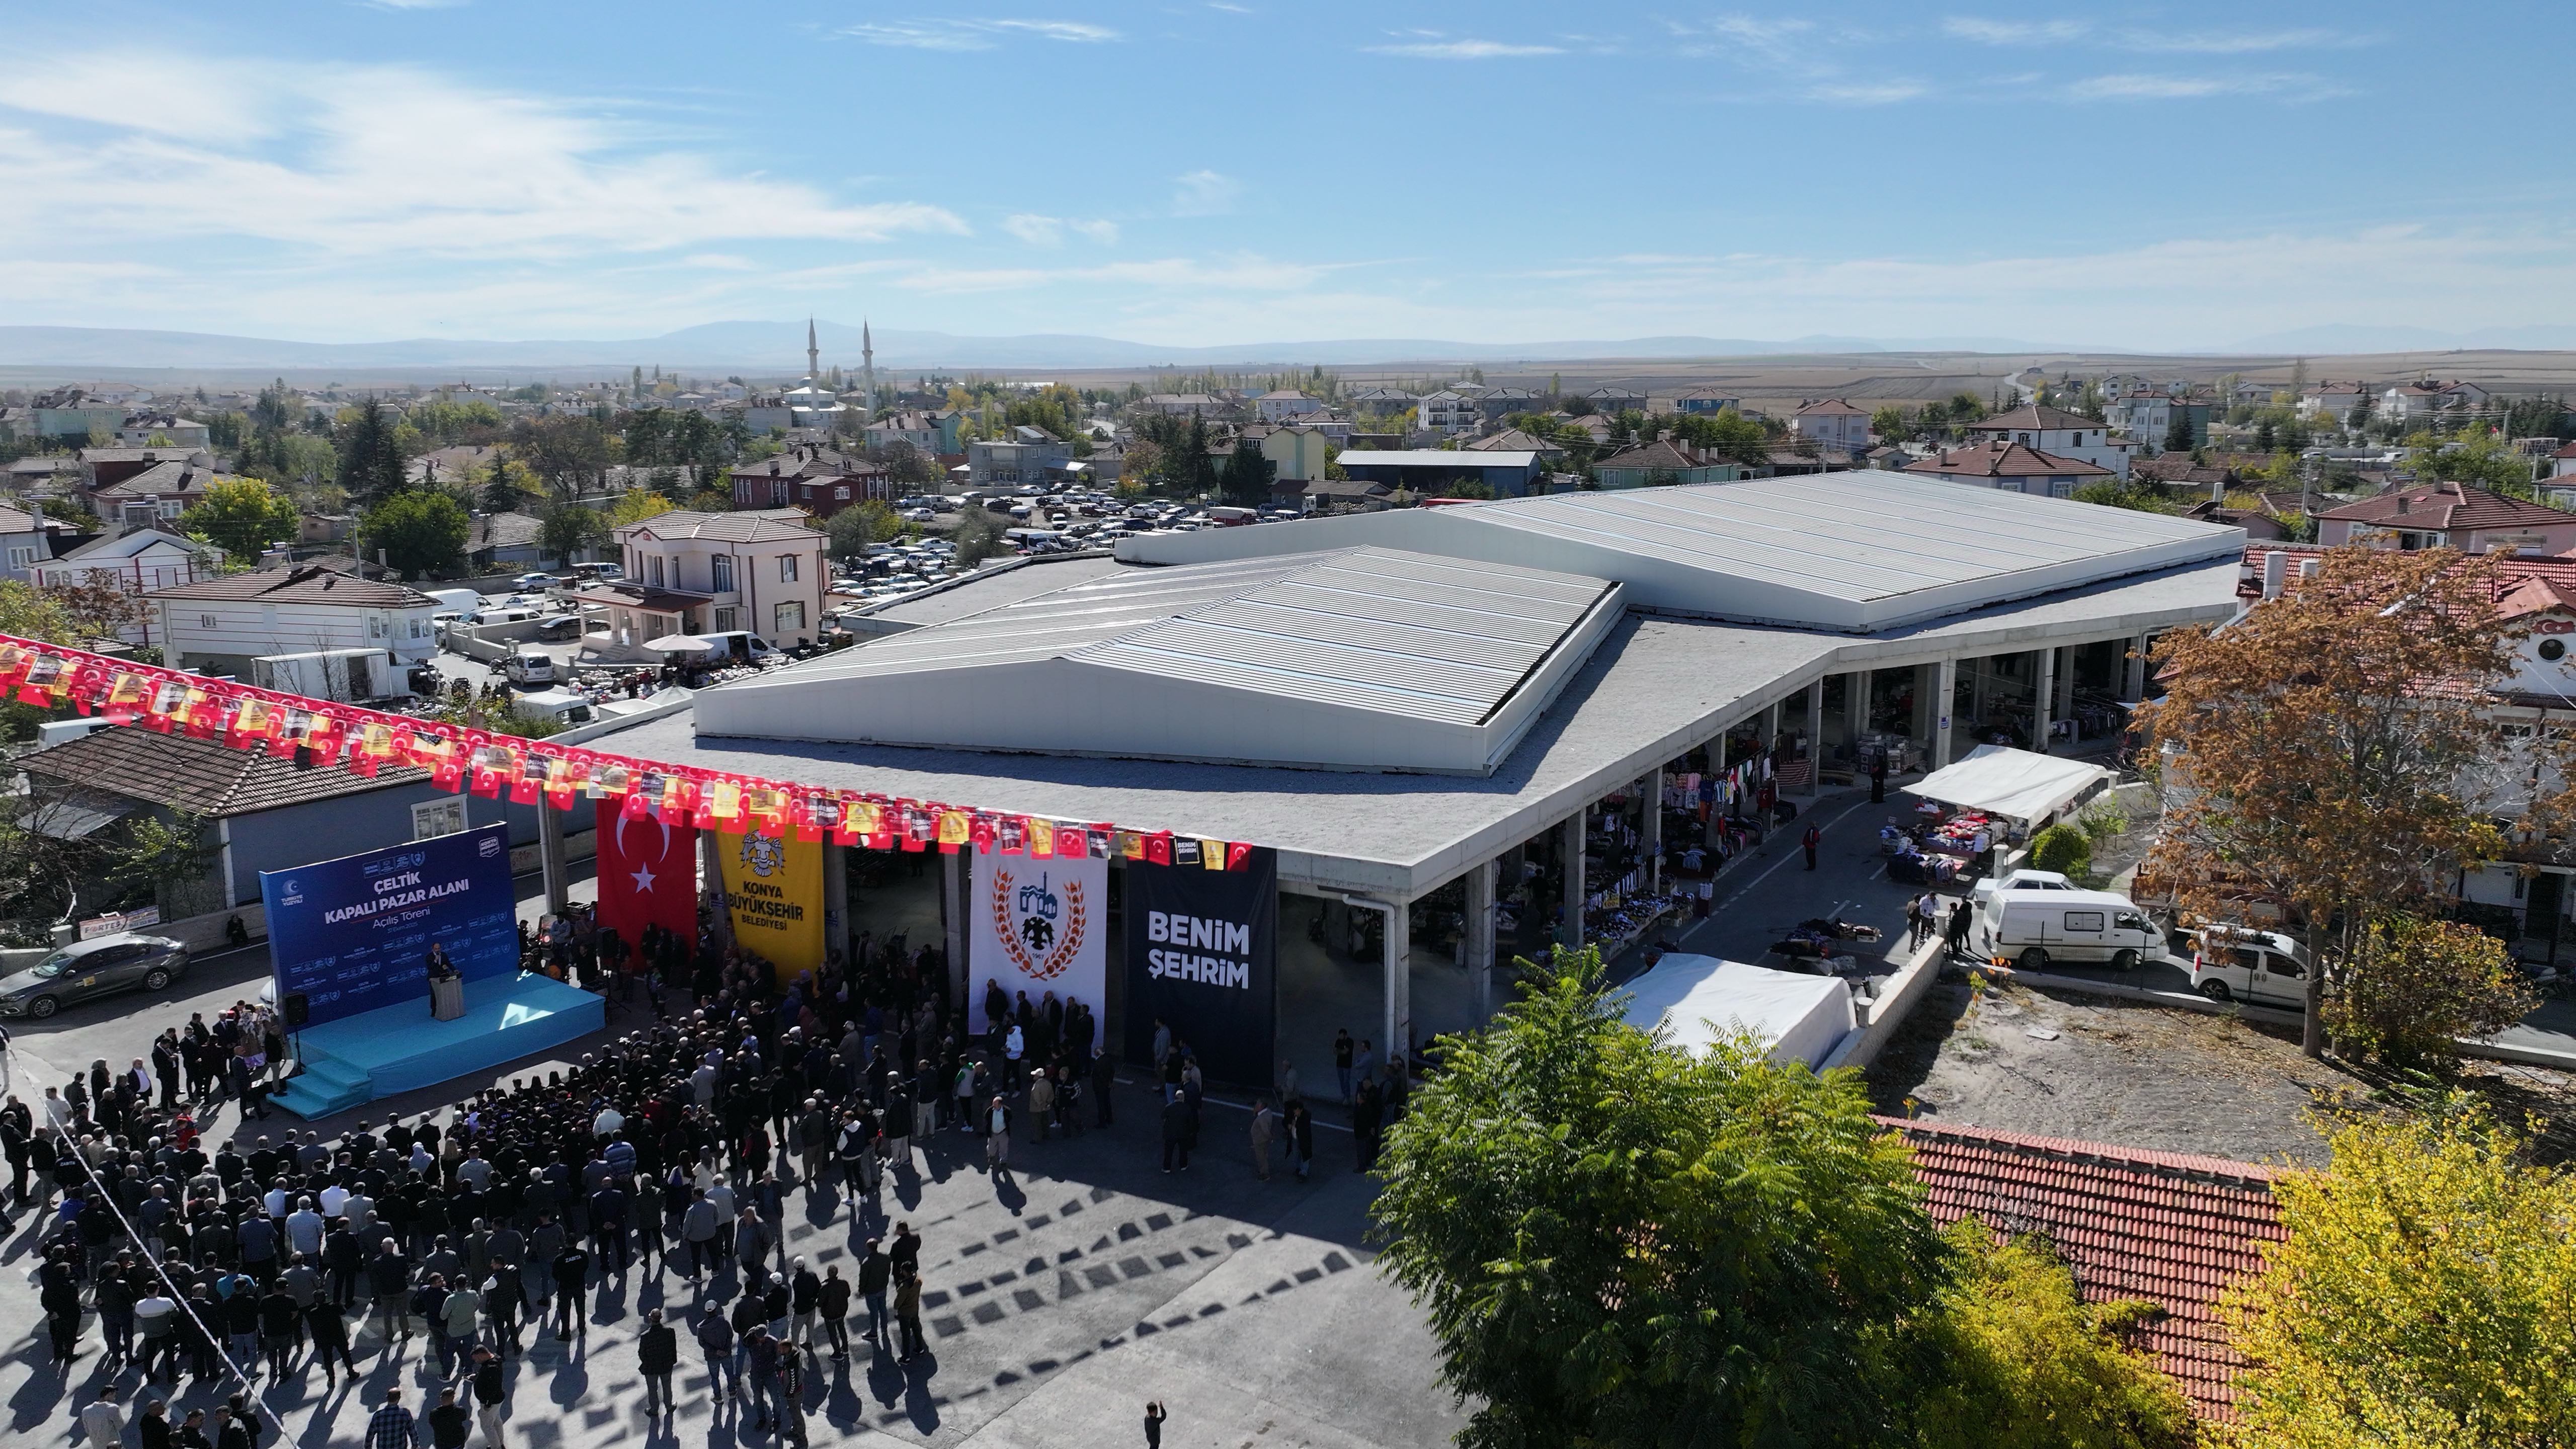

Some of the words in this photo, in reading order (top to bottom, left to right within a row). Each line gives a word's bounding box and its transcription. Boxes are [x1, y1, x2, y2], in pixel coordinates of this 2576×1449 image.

[374, 871, 421, 895] ÇELTİK
[743, 881, 783, 899] KONYA
[325, 901, 377, 924] KAPALI
[379, 890, 426, 911] PAZAR
[429, 879, 469, 899] ALANI
[728, 894, 803, 921] BÜYÜKŞEHİR
[372, 914, 399, 929] Açılış
[400, 906, 431, 922] Töreni
[741, 914, 787, 931] BELEDİYESİ
[1148, 910, 1250, 955] BENİM
[1147, 948, 1249, 990] ŞEHRİM
